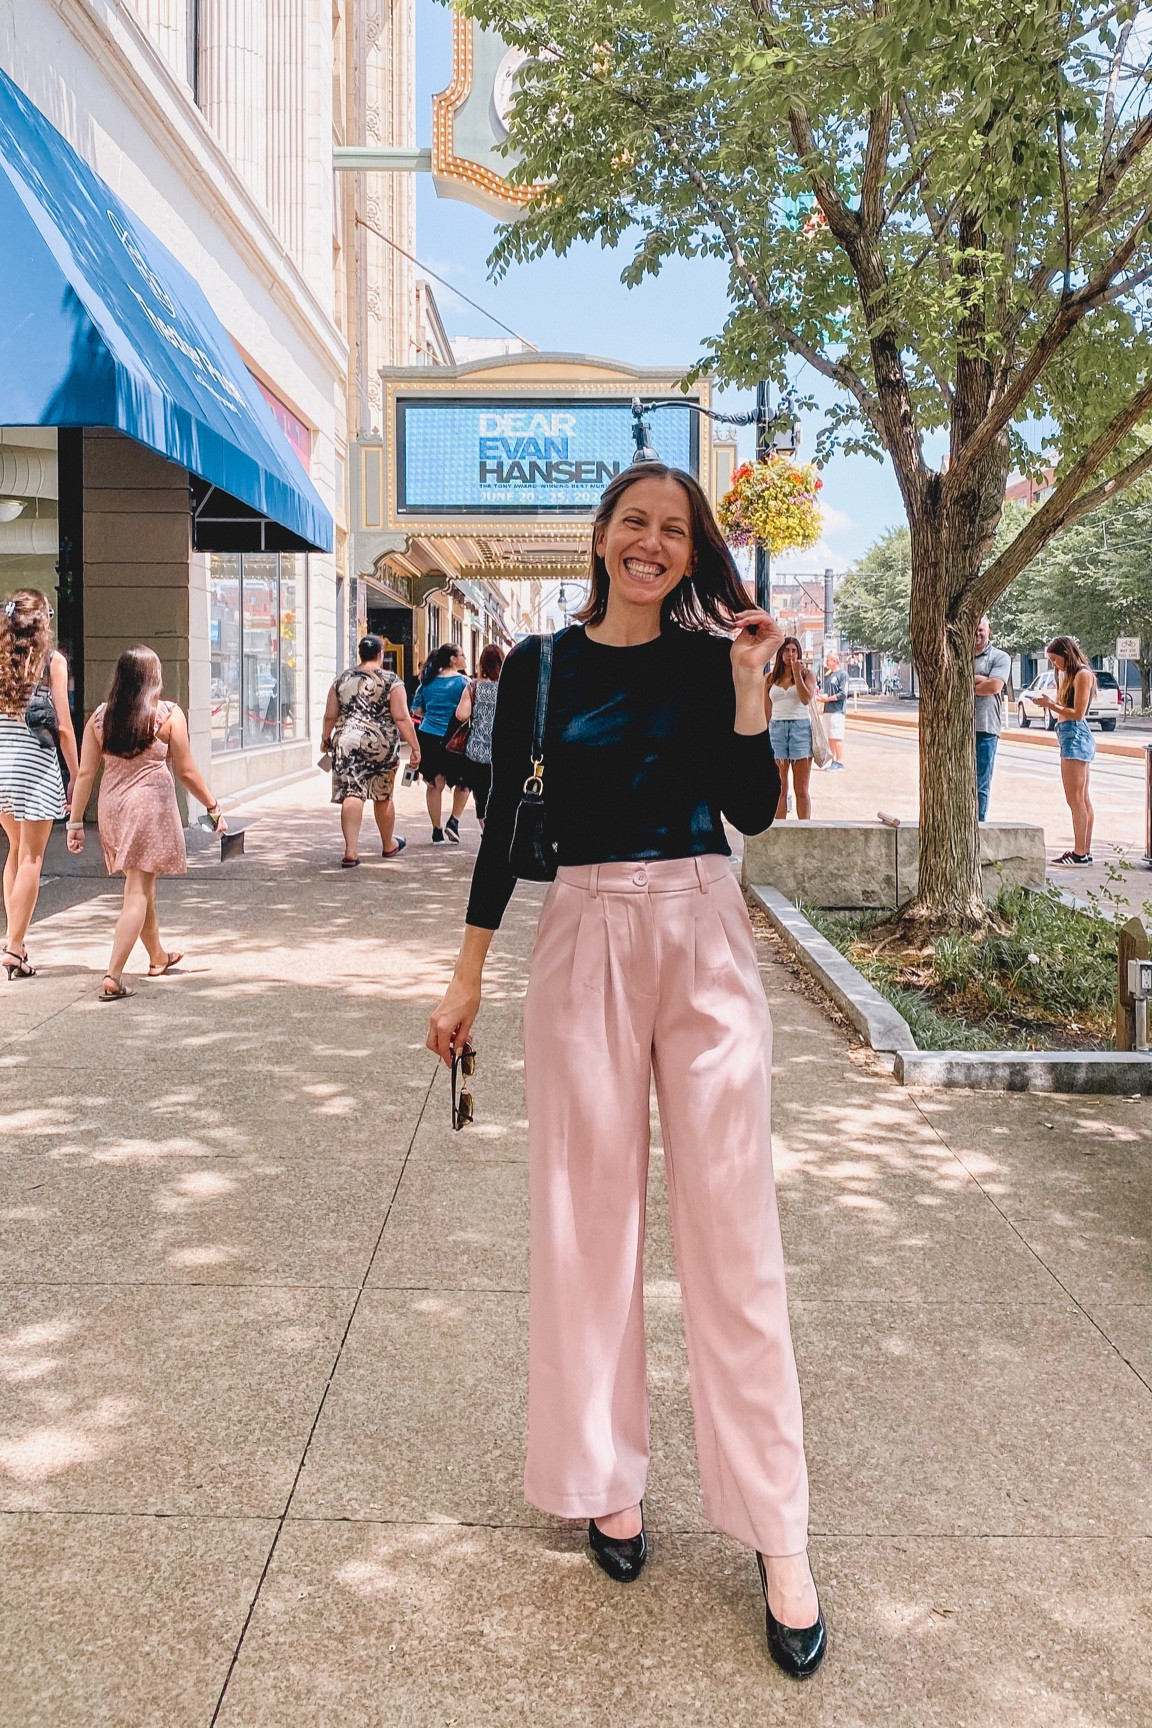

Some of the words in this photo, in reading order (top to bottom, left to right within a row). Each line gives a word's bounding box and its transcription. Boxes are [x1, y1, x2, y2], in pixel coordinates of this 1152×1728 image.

[479, 413, 577, 437] DEAR
[479, 437, 569, 460] EVAN
[479, 460, 620, 484] HANSEN
[481, 491, 514, 502] JUNE
[519, 491, 535, 502] 20
[574, 491, 600, 503] 202
